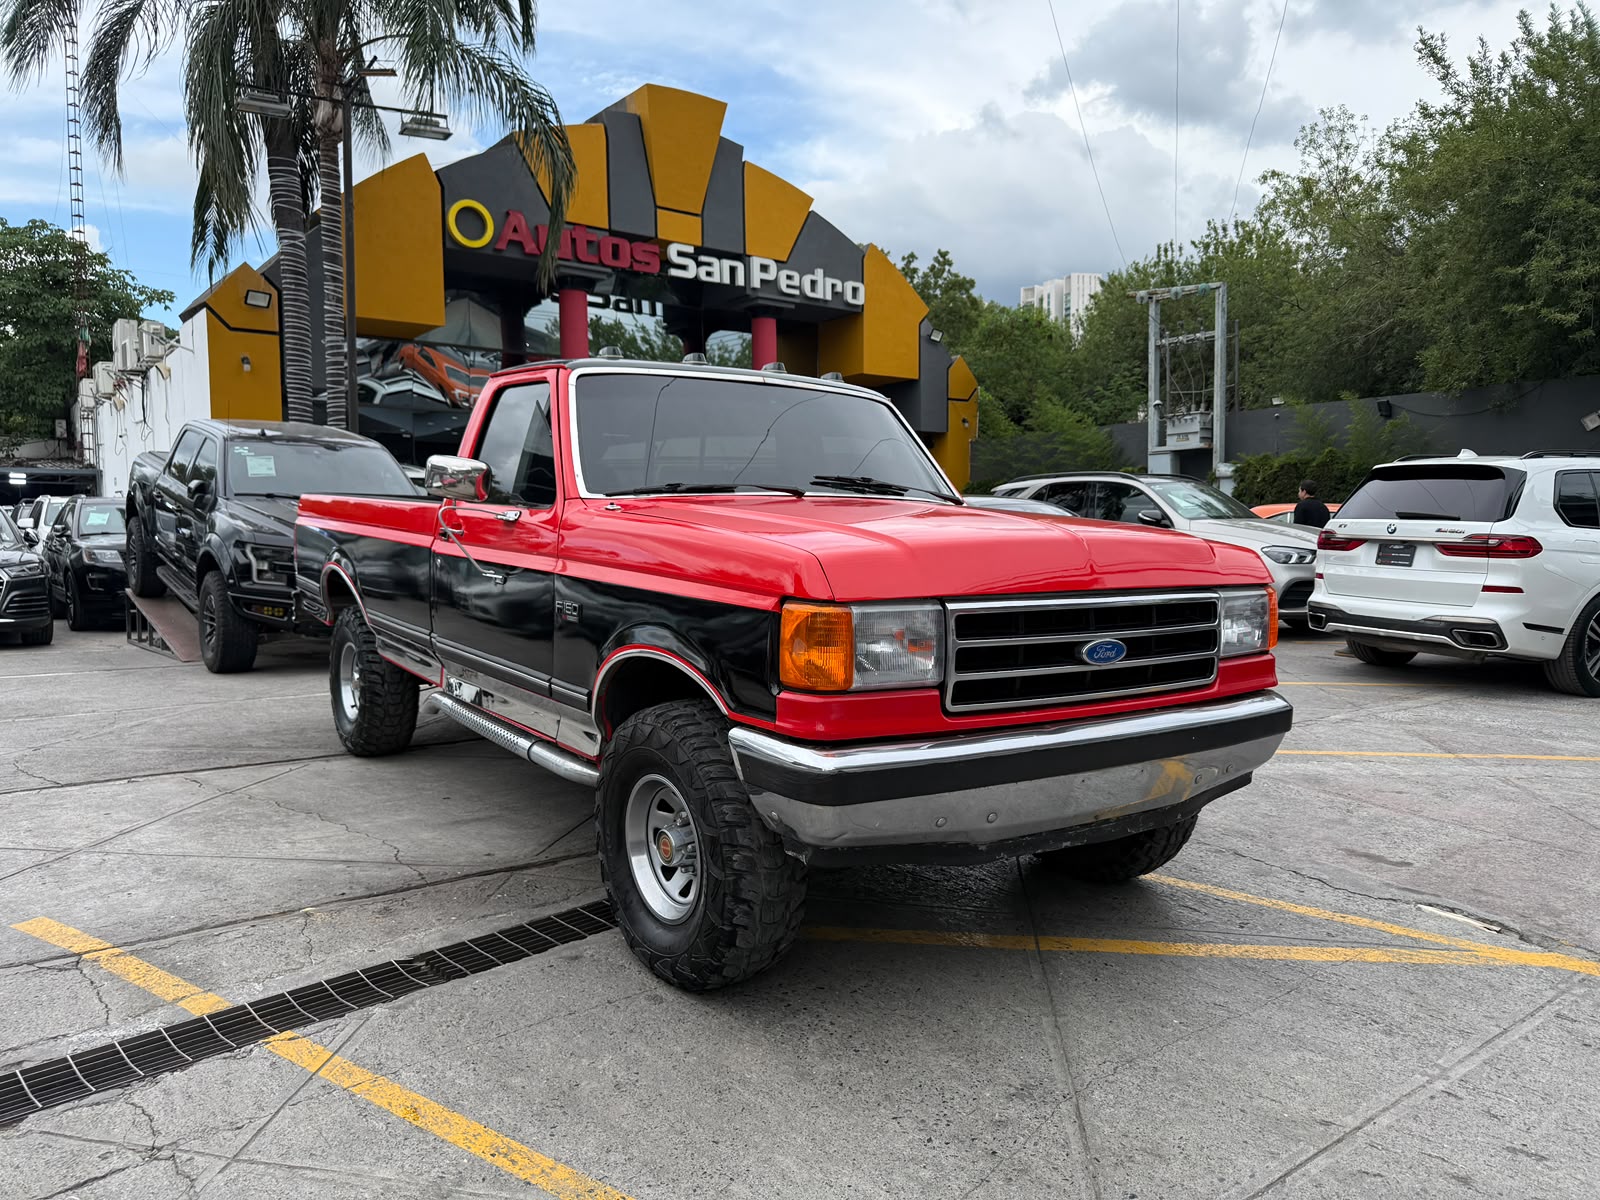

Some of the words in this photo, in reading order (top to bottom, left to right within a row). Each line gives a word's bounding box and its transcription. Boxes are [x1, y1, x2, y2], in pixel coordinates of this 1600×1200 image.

[495, 209, 661, 273] Autos
[667, 242, 745, 287] San
[750, 255, 865, 306] Pedro
[1093, 645, 1118, 659] Ford
